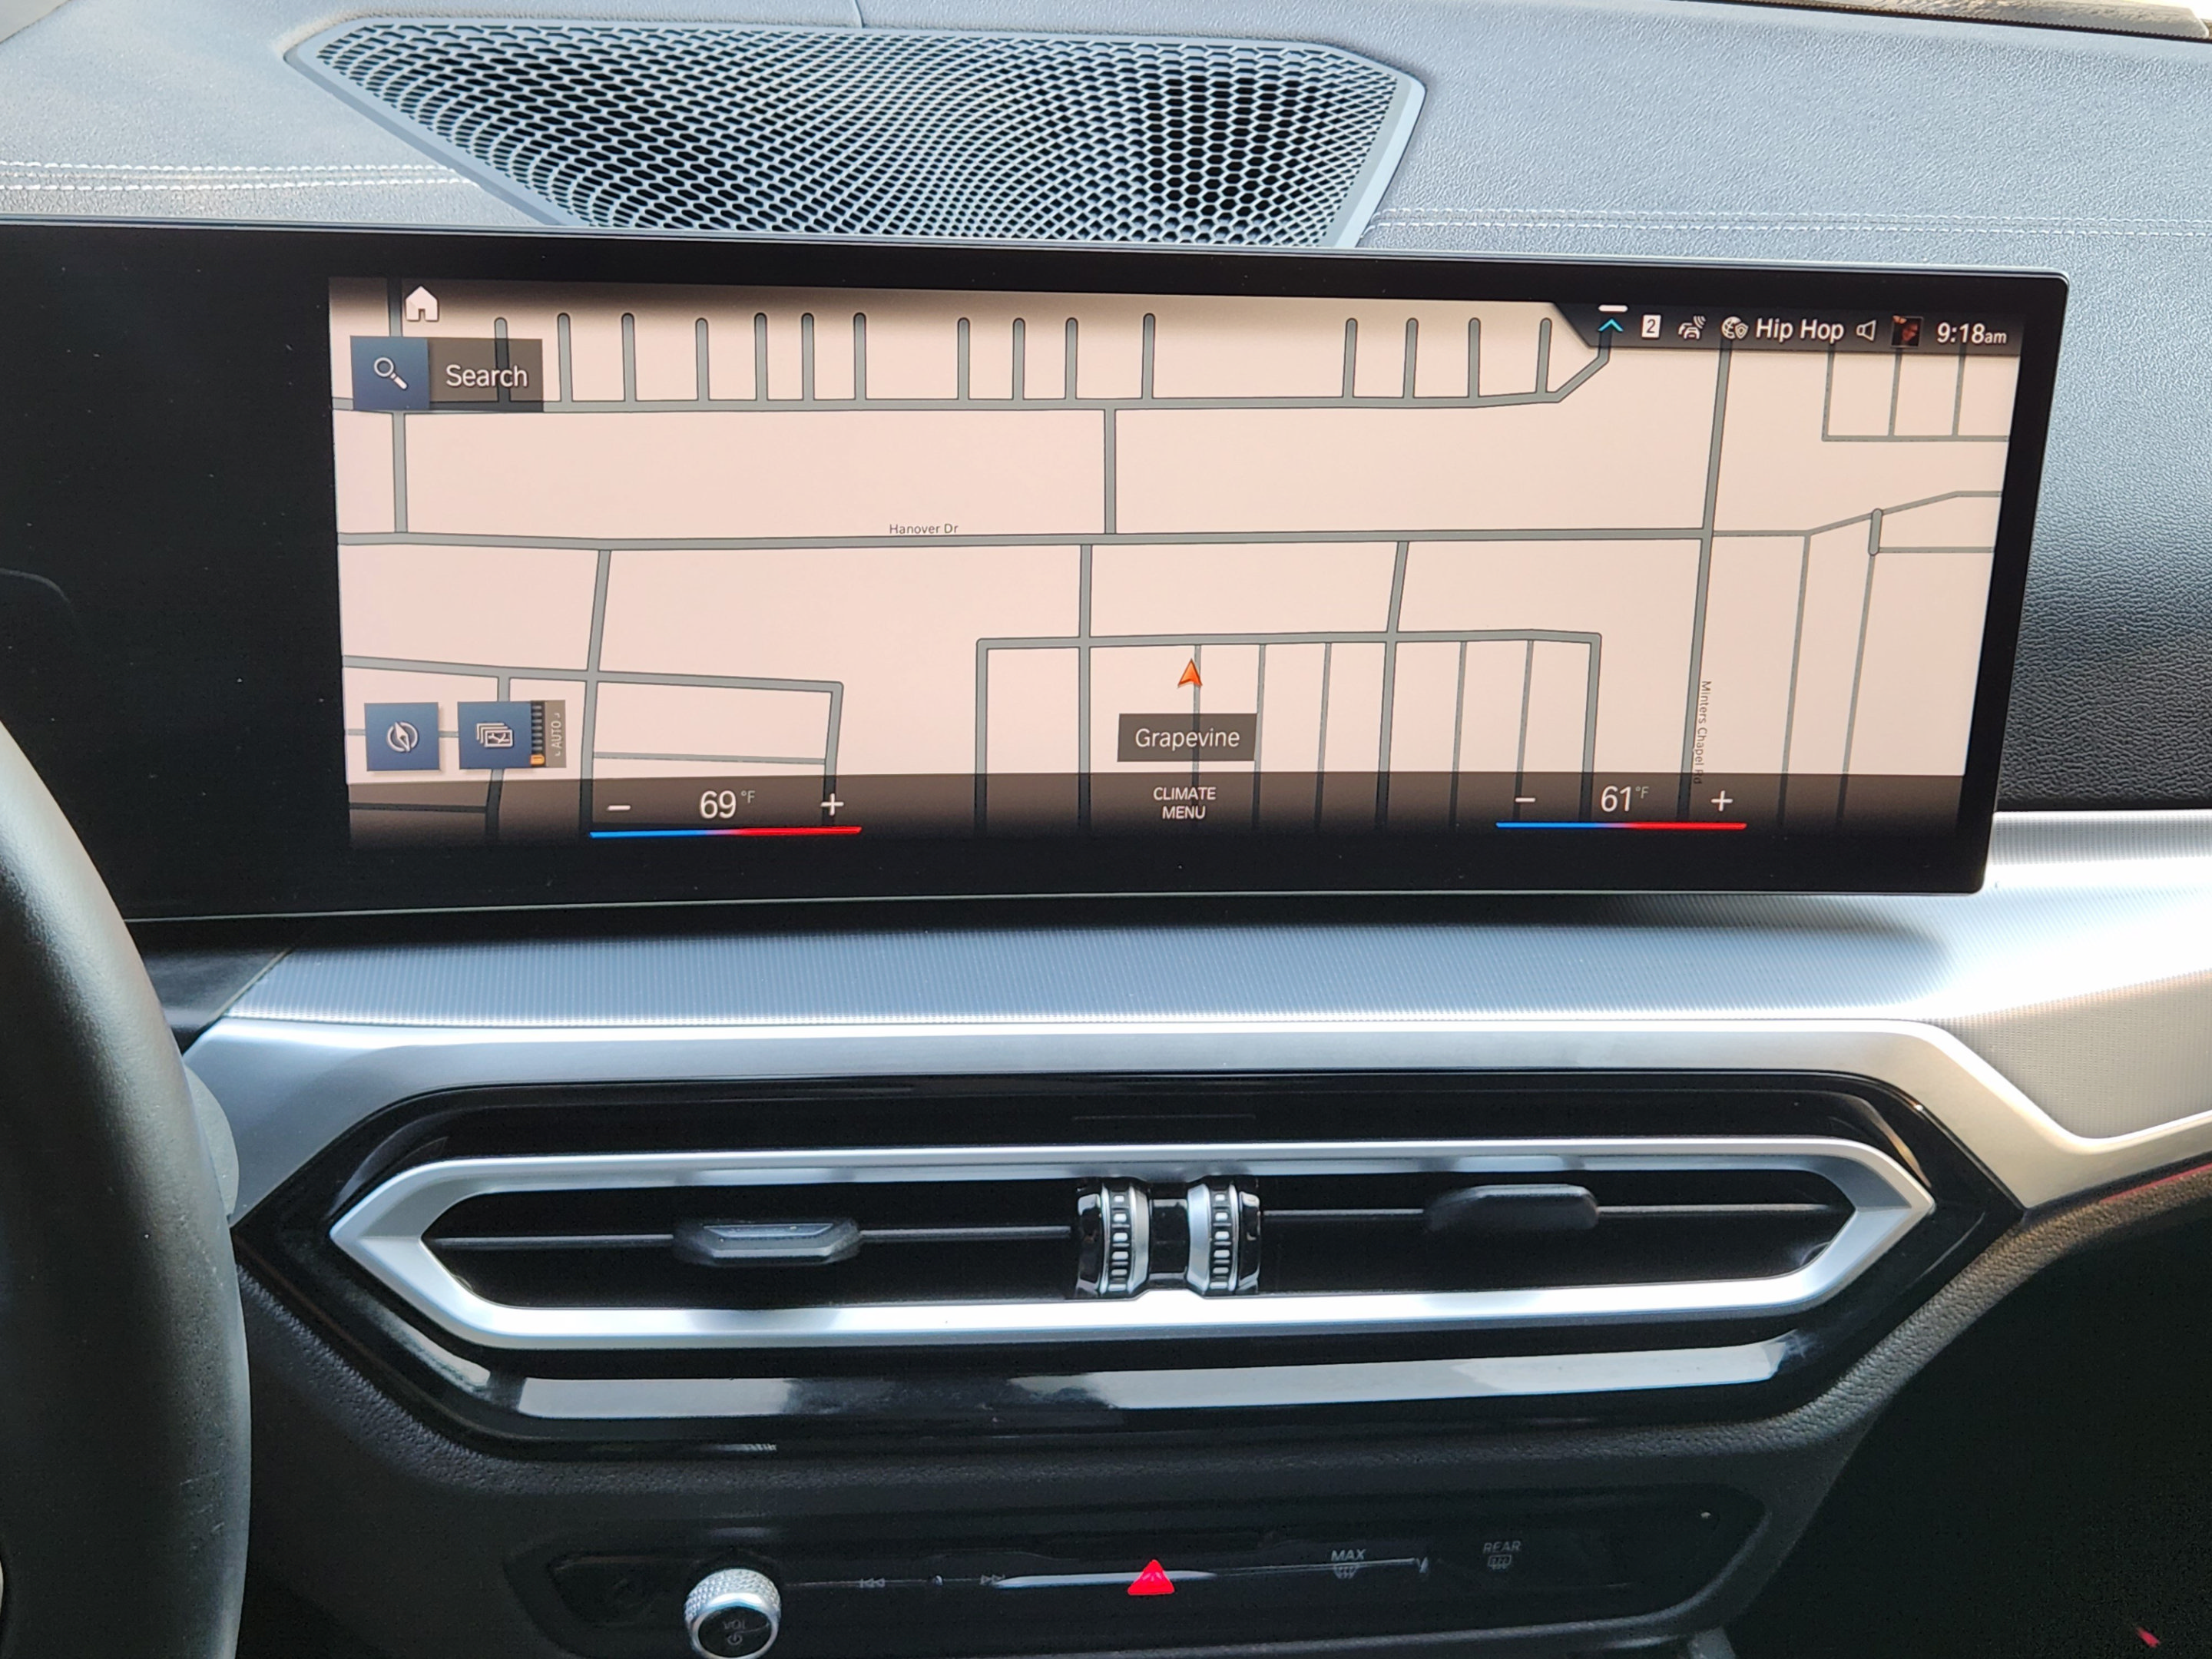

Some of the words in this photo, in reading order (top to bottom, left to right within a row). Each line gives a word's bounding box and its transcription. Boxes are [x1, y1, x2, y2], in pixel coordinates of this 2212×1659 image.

[1755, 317, 1794, 343] Hip
[1800, 318, 1844, 344] Hop
[445, 363, 528, 389] Search
[889, 523, 940, 535] Hanover
[943, 522, 959, 534] Dr
[1698, 680, 1712, 724] Minters
[550, 720, 564, 749] AUTO
[1134, 727, 1241, 752] Grapevine
[1694, 727, 1708, 766] Chapel
[1693, 768, 1704, 785] Rd
[1152, 786, 1217, 801] CLIMATE
[1161, 805, 1207, 820] MENU
[1330, 1548, 1366, 1563] MAX
[1482, 1540, 1522, 1554] REAR
